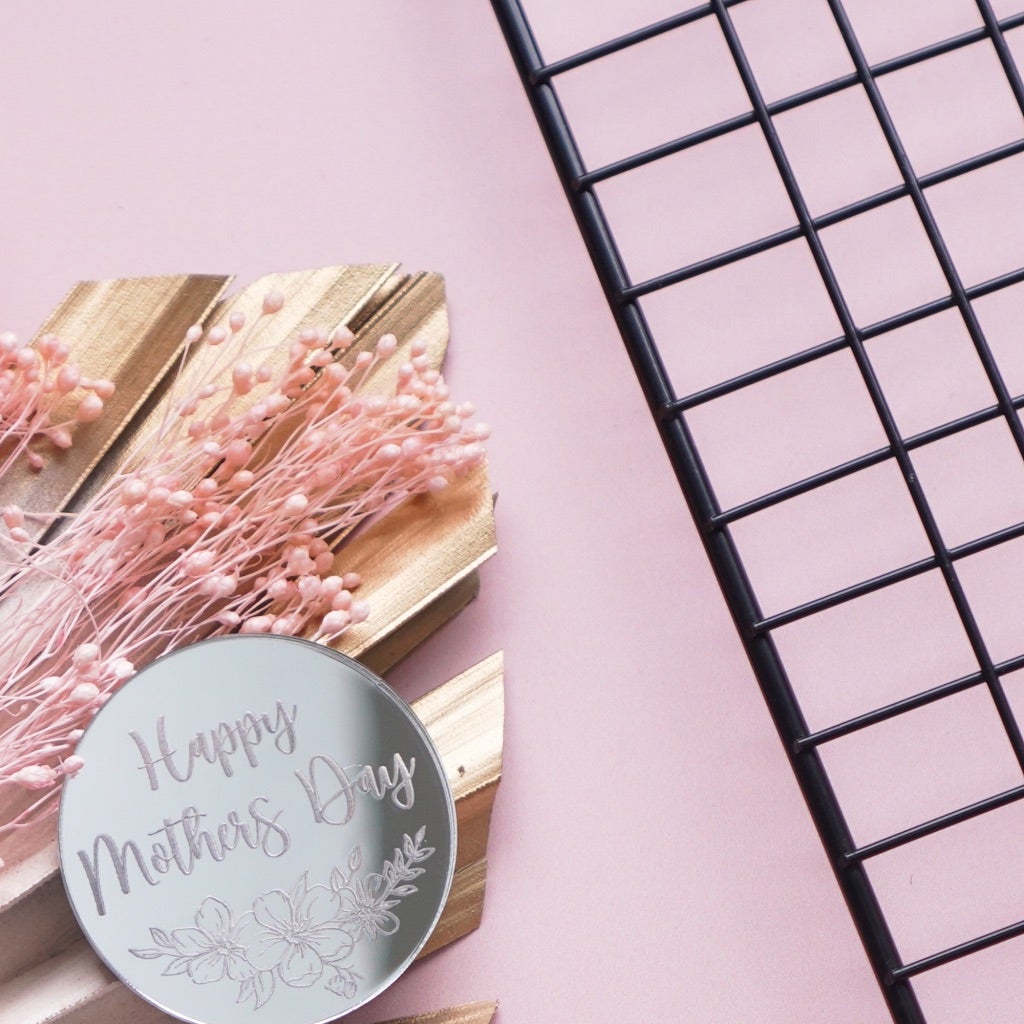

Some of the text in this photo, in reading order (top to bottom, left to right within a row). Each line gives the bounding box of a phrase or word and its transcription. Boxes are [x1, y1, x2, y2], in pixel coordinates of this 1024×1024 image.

[129, 700, 297, 790] Happy
[77, 753, 416, 916] Mothers Day
